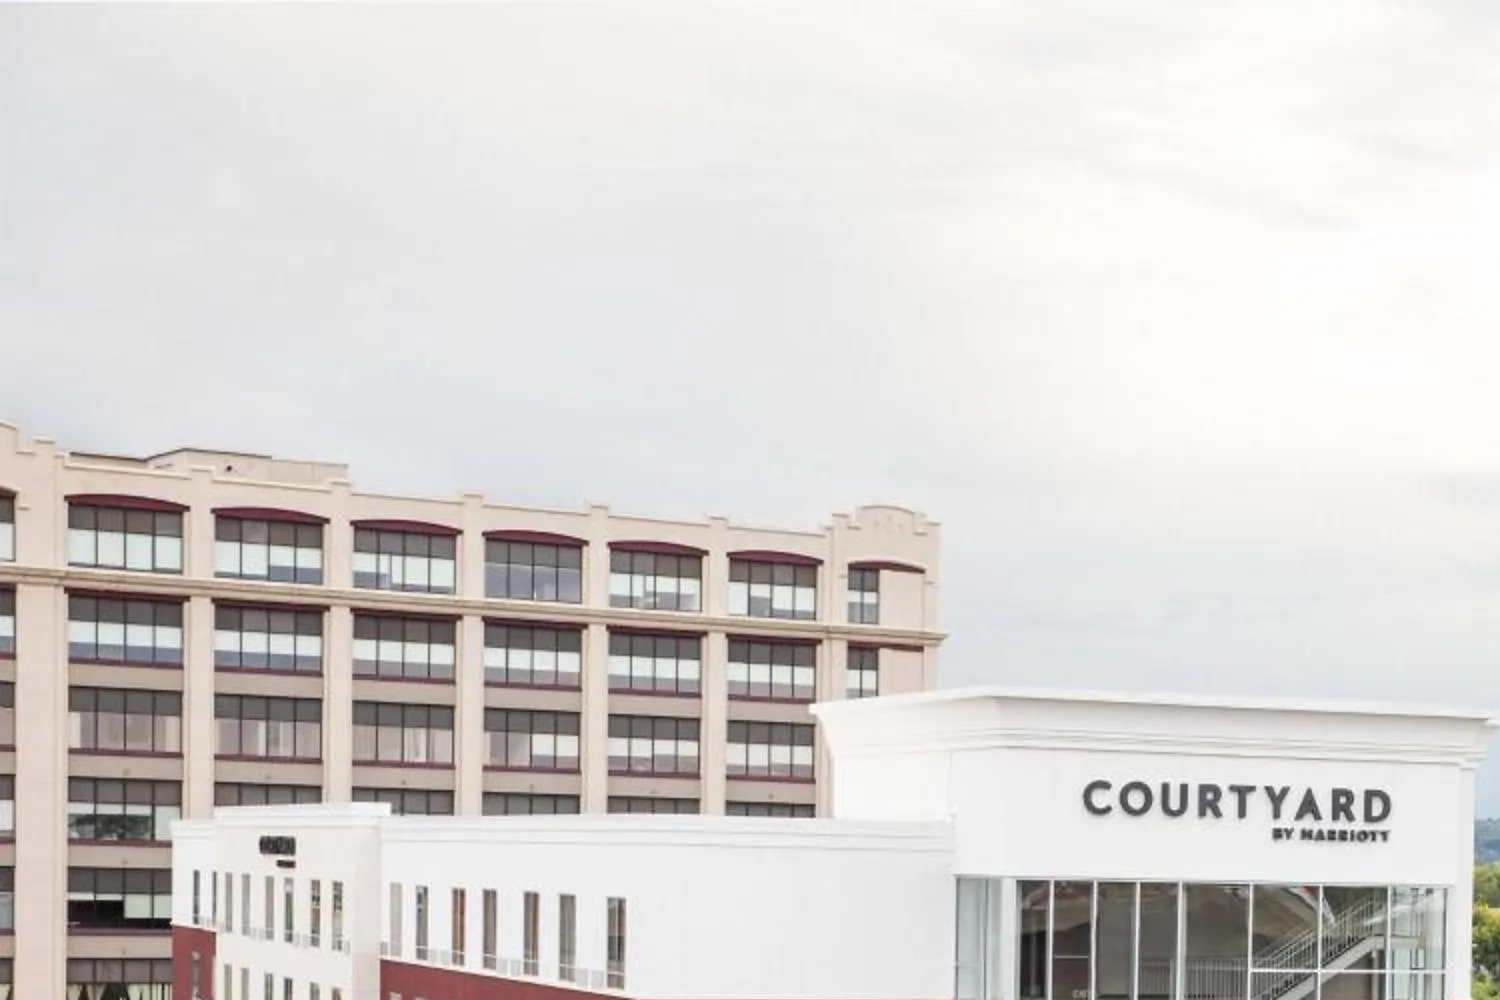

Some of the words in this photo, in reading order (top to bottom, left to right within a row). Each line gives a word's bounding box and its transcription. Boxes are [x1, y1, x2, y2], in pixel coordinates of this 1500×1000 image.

[1082, 779, 1392, 823] COURTYARD
[1272, 827, 1294, 842] BY
[1300, 828, 1390, 842] MARRIOTT
